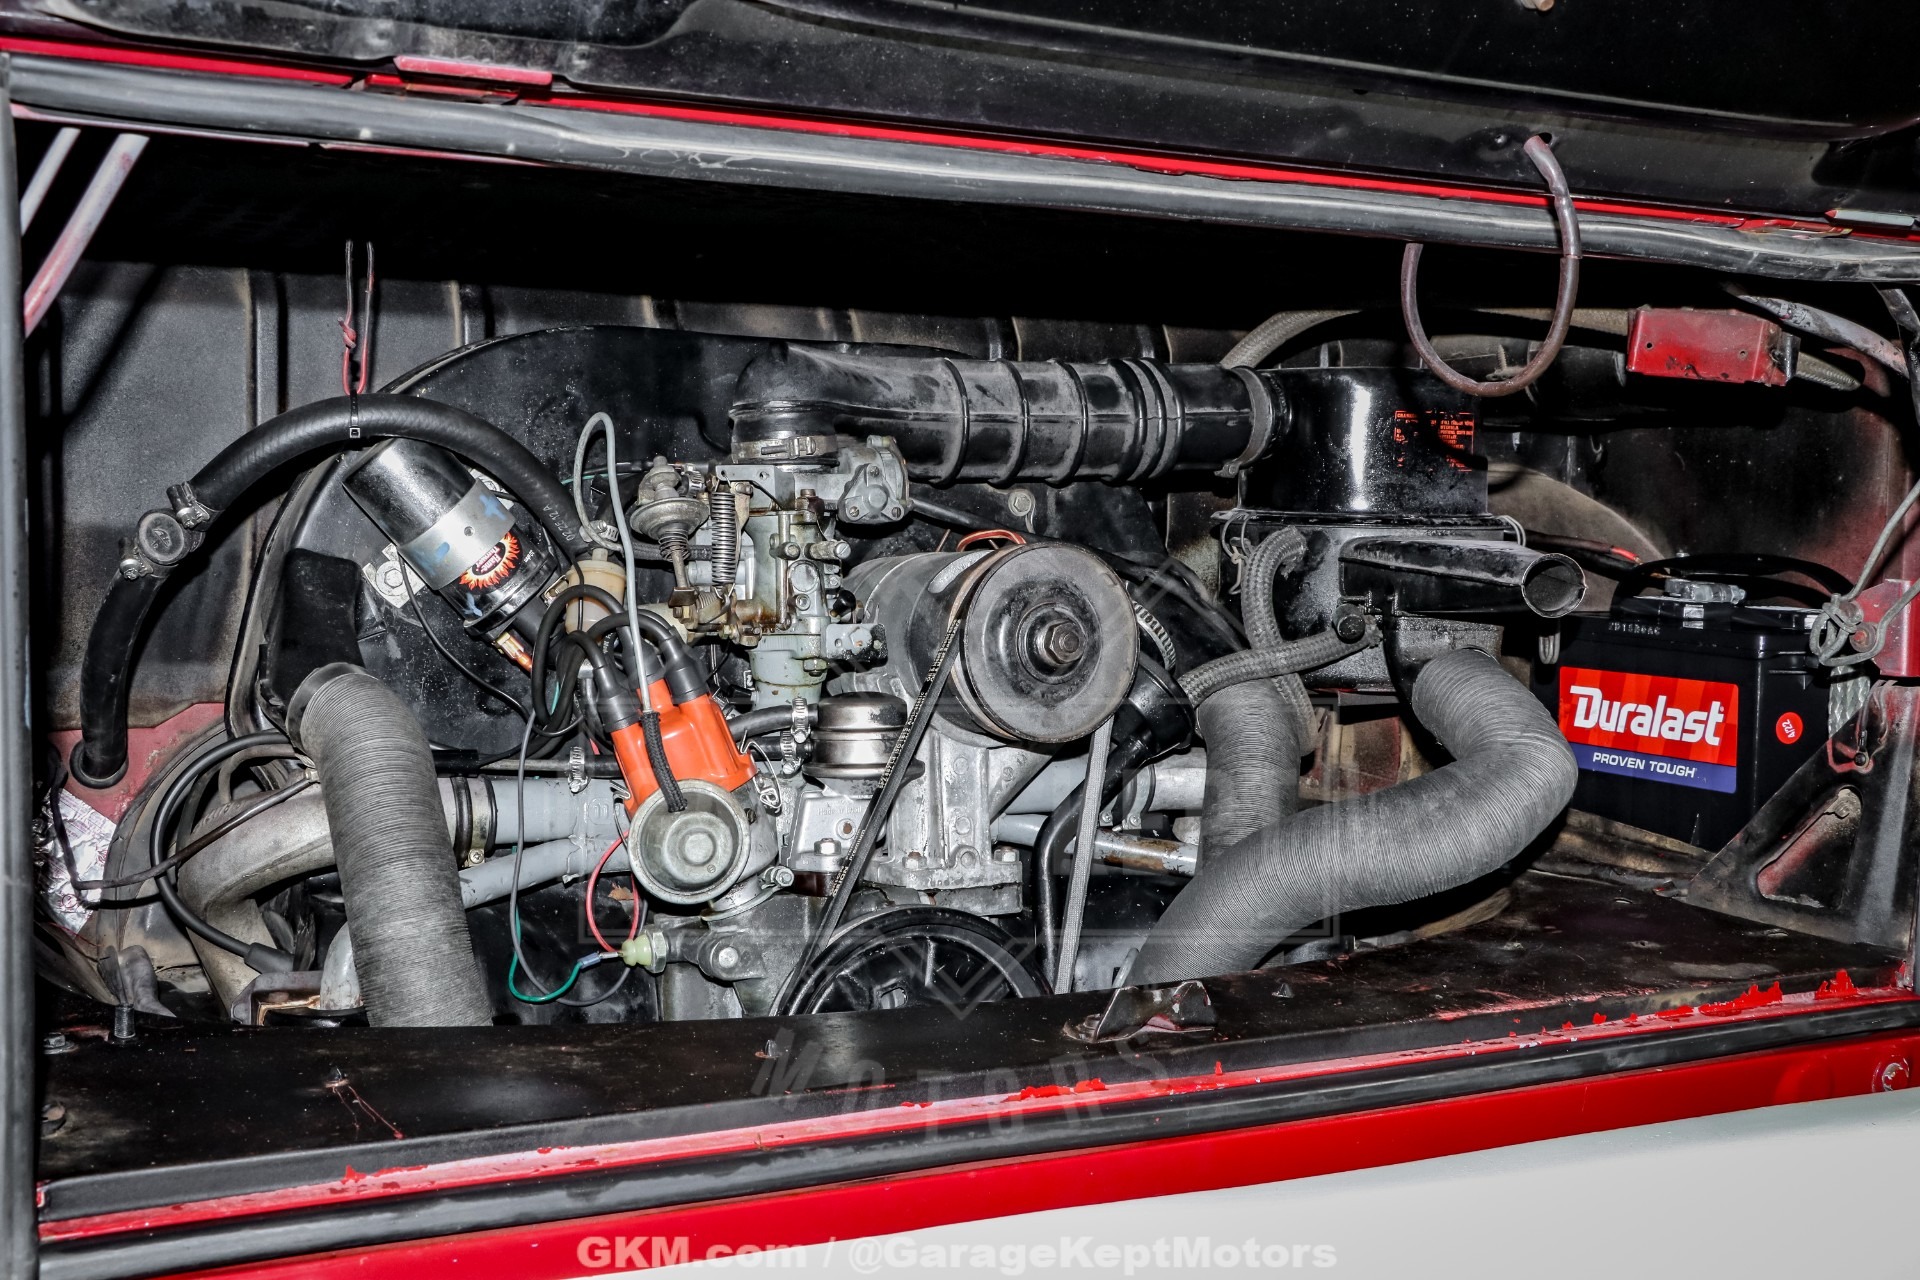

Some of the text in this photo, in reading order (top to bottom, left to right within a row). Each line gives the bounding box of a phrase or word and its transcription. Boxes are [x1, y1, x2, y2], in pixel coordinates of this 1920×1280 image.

[1569, 685, 1725, 746] Duralast
[1592, 752, 1695, 778] PROVEN TOUGH
